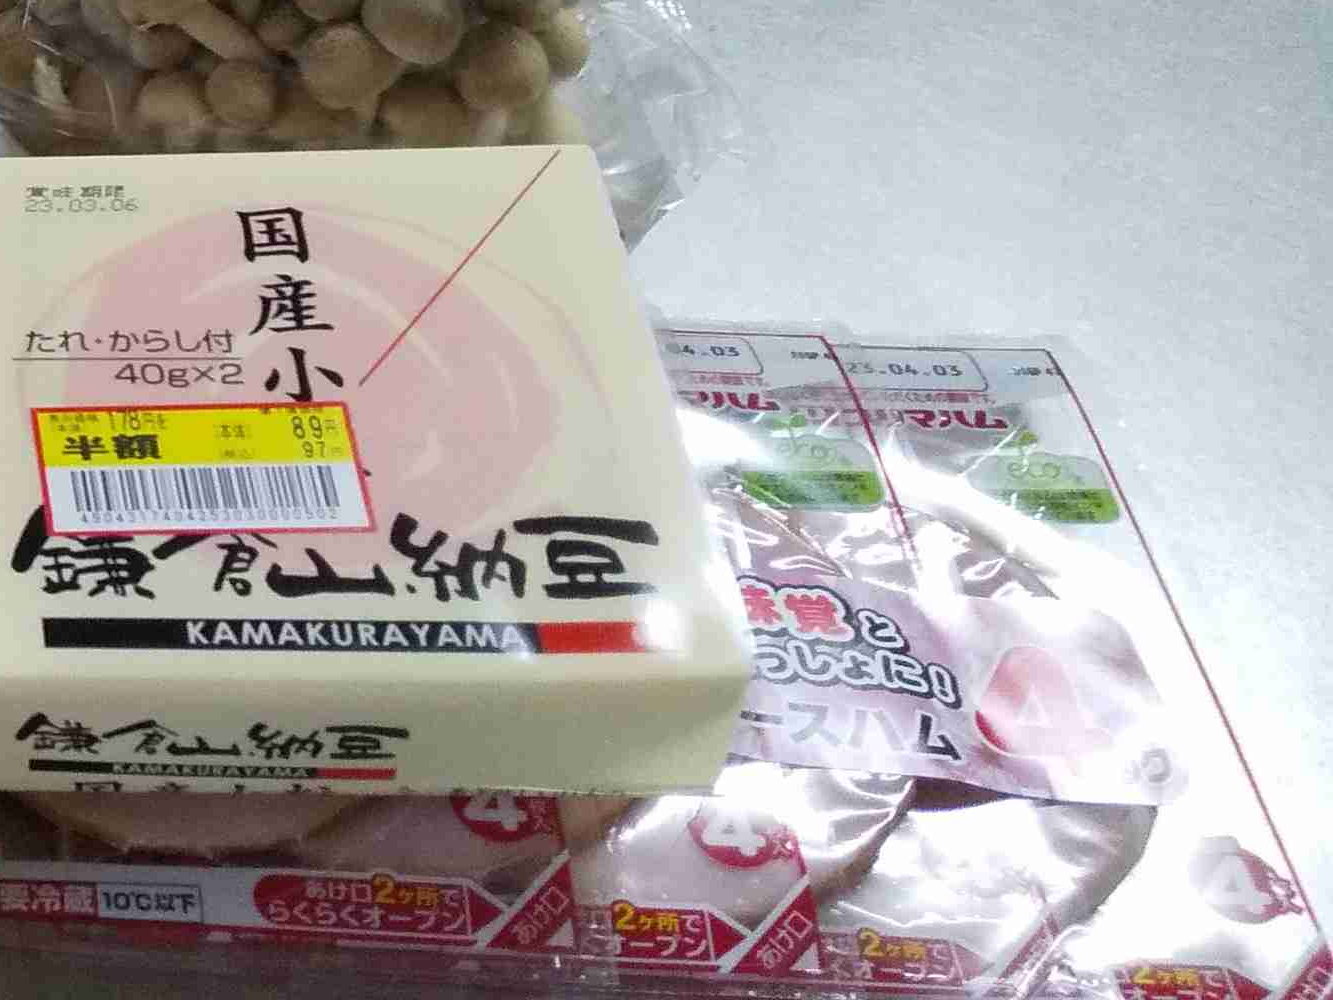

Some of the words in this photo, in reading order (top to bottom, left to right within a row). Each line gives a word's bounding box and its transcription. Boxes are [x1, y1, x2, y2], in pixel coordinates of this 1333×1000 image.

[23, 198, 140, 214] 23.03.06
[236, 206, 345, 403] 国産小
[24, 328, 234, 354] たれ・からし付
[61, 434, 163, 461] 半額
[10, 505, 662, 602] 鎌倉山納豆
[184, 621, 527, 650] KAMAKURAYAMA
[14, 712, 411, 759] 鎌倉山納豆
[111, 764, 312, 778] KAMAKURAYAMA
[267, 900, 468, 934] らくらくオープン
